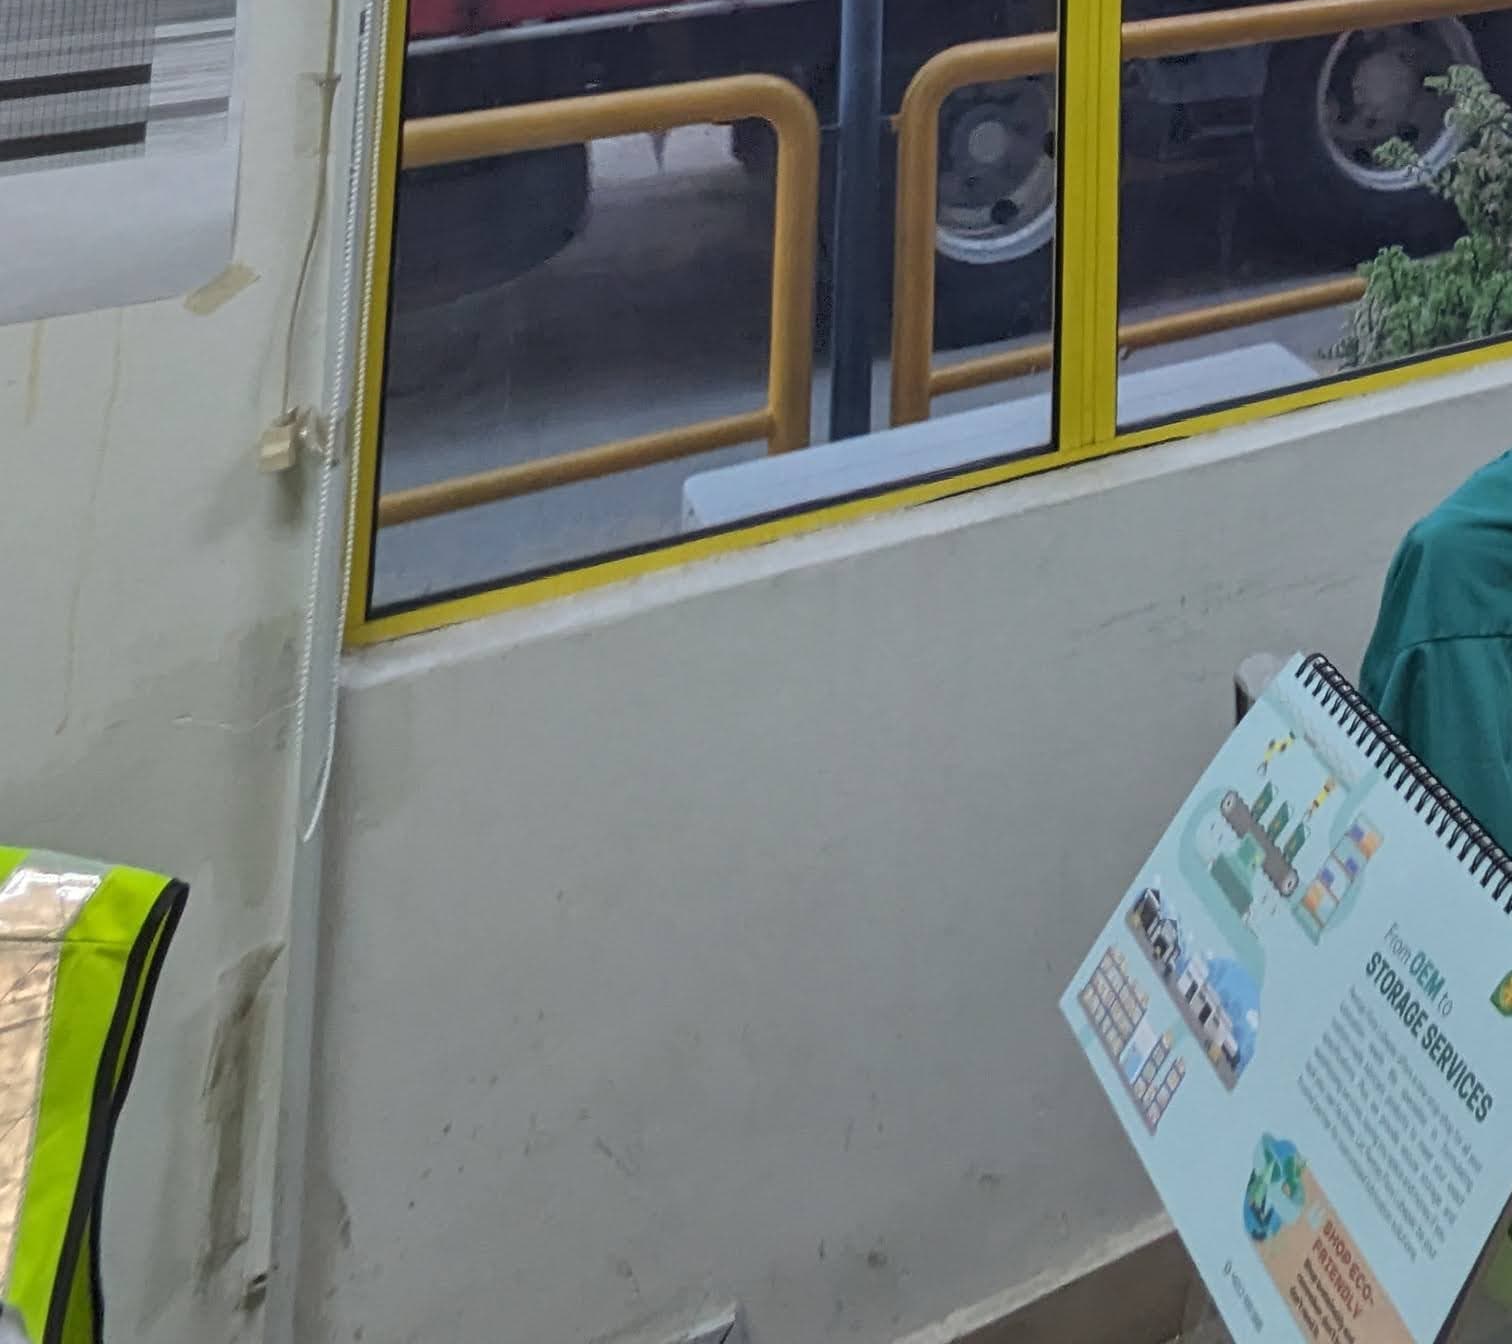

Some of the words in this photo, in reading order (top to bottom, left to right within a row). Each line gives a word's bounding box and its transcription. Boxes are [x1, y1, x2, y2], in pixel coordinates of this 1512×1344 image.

[1366, 952, 1428, 1039] STORAGE
[1421, 1024, 1493, 1123] SERVICES
[1409, 951, 1446, 1003] OEM
[1438, 993, 1454, 1017] to
